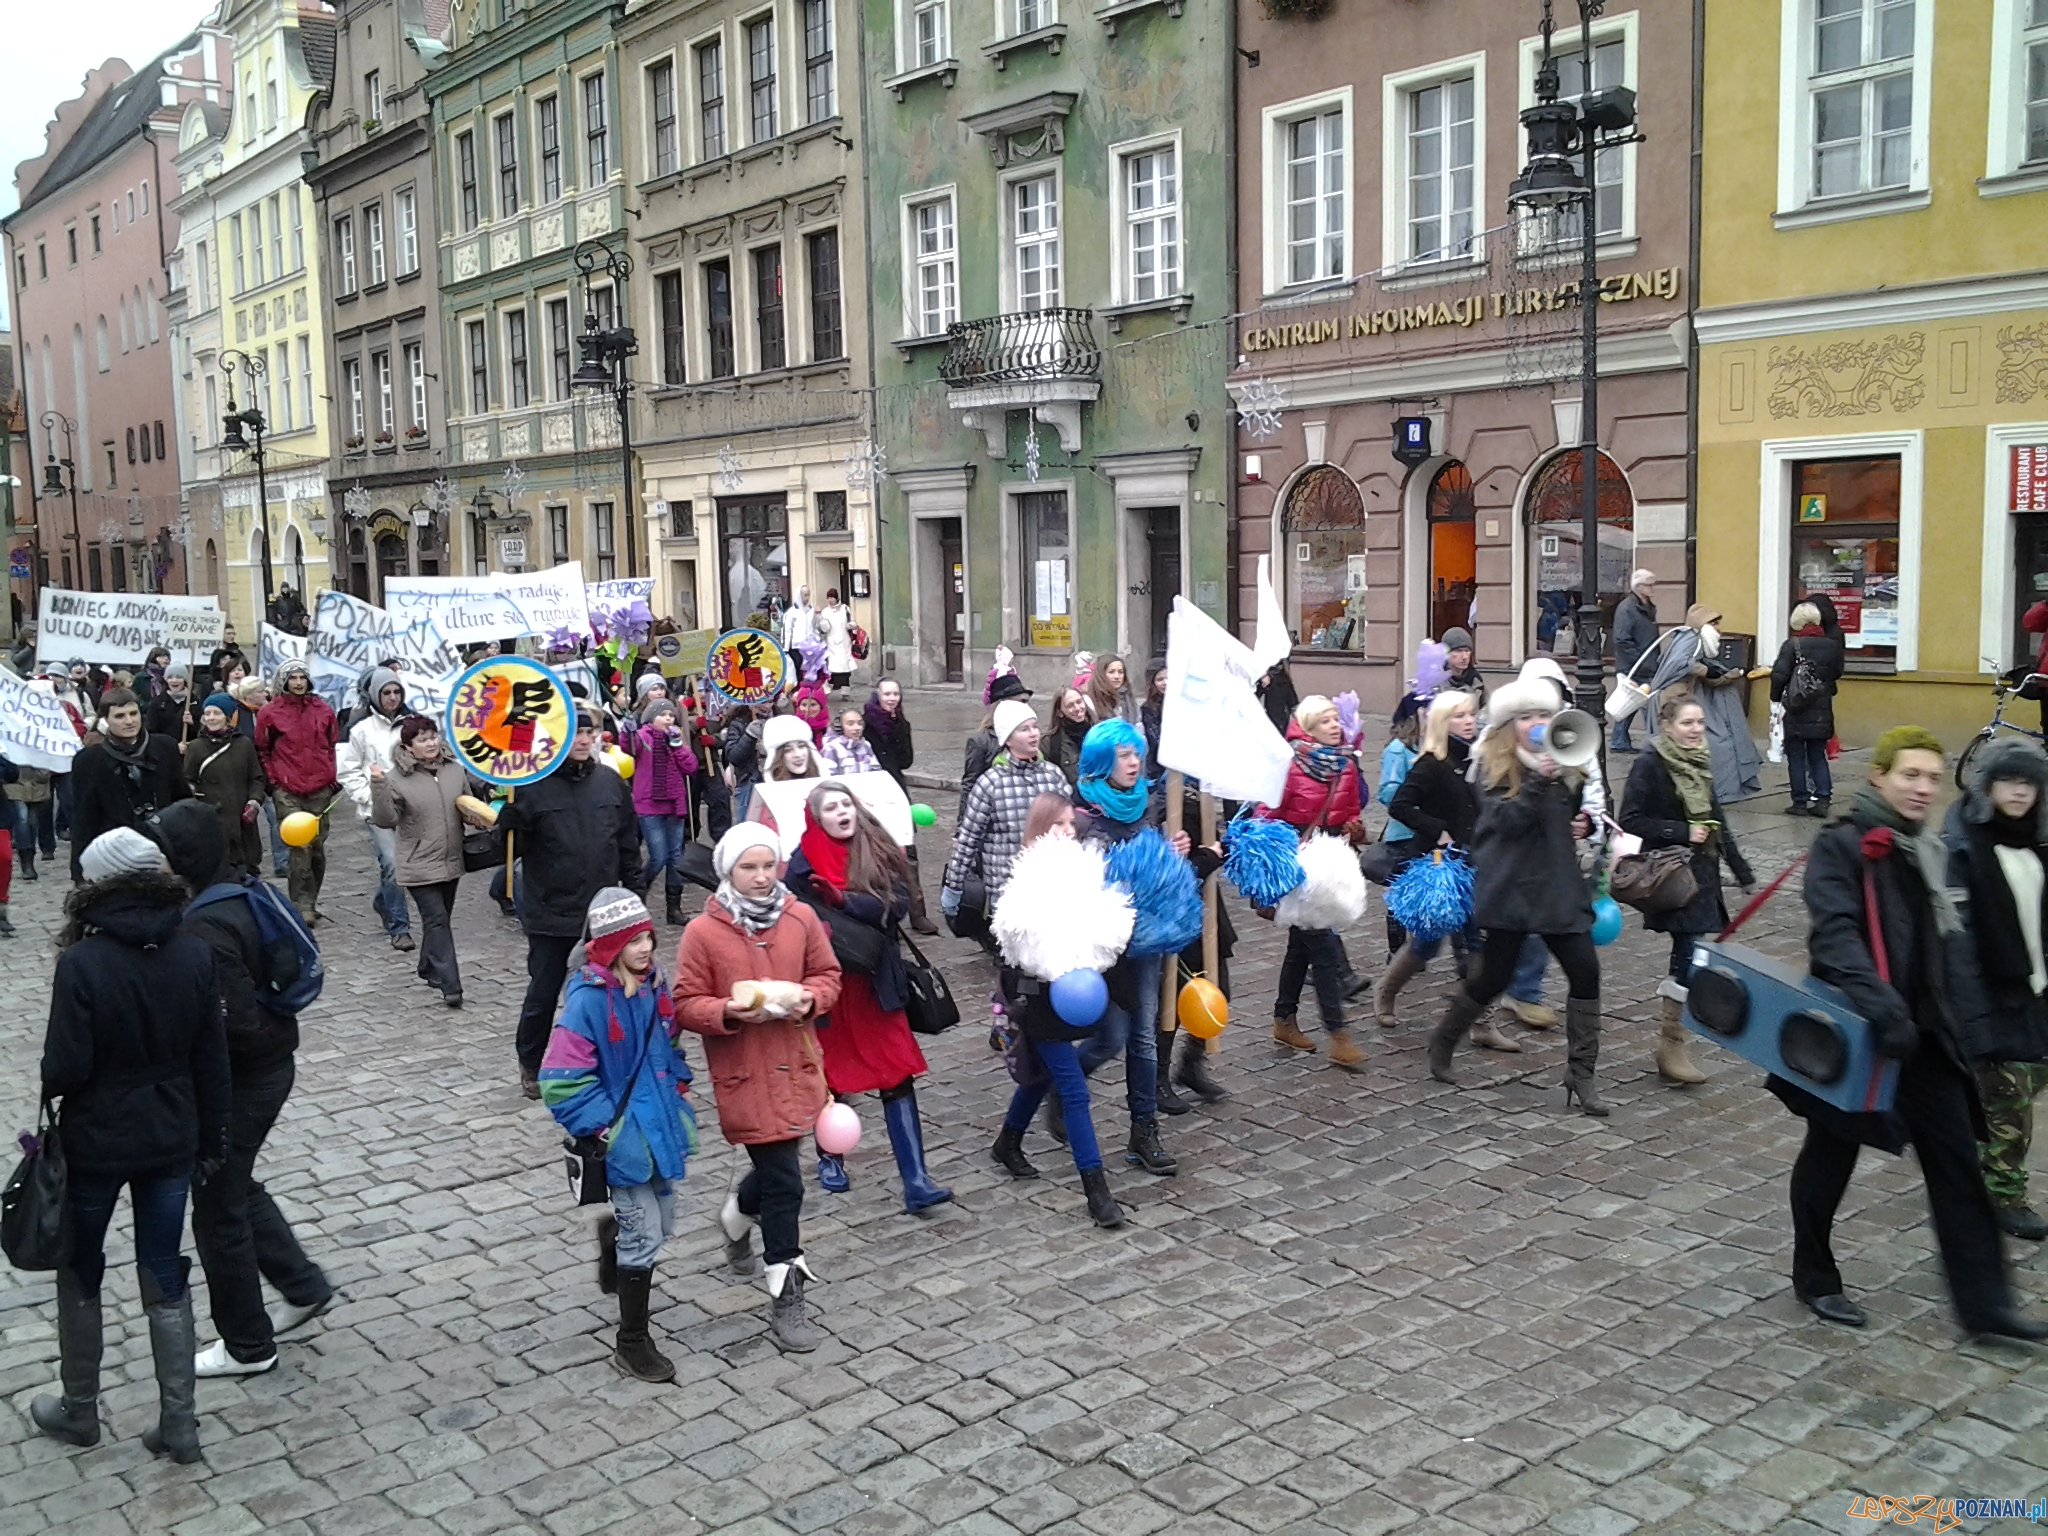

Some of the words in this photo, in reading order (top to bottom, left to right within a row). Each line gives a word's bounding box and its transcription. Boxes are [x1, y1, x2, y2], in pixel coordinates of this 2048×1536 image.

[1243, 317, 1340, 352] CENTRUM
[1347, 294, 1483, 338] INFORMACJI
[1490, 266, 1681, 319] TURYSTCZNEJ
[2034, 446, 2048, 477] CLUB
[2016, 446, 2031, 511] RESTAURANT
[2033, 480, 2047, 511] CAFE
[173, 623, 188, 632] NO
[189, 623, 217, 635] NAME
[709, 668, 731, 681] LAT
[710, 652, 733, 668] 35
[456, 683, 498, 712] 35
[455, 709, 489, 730] LAT
